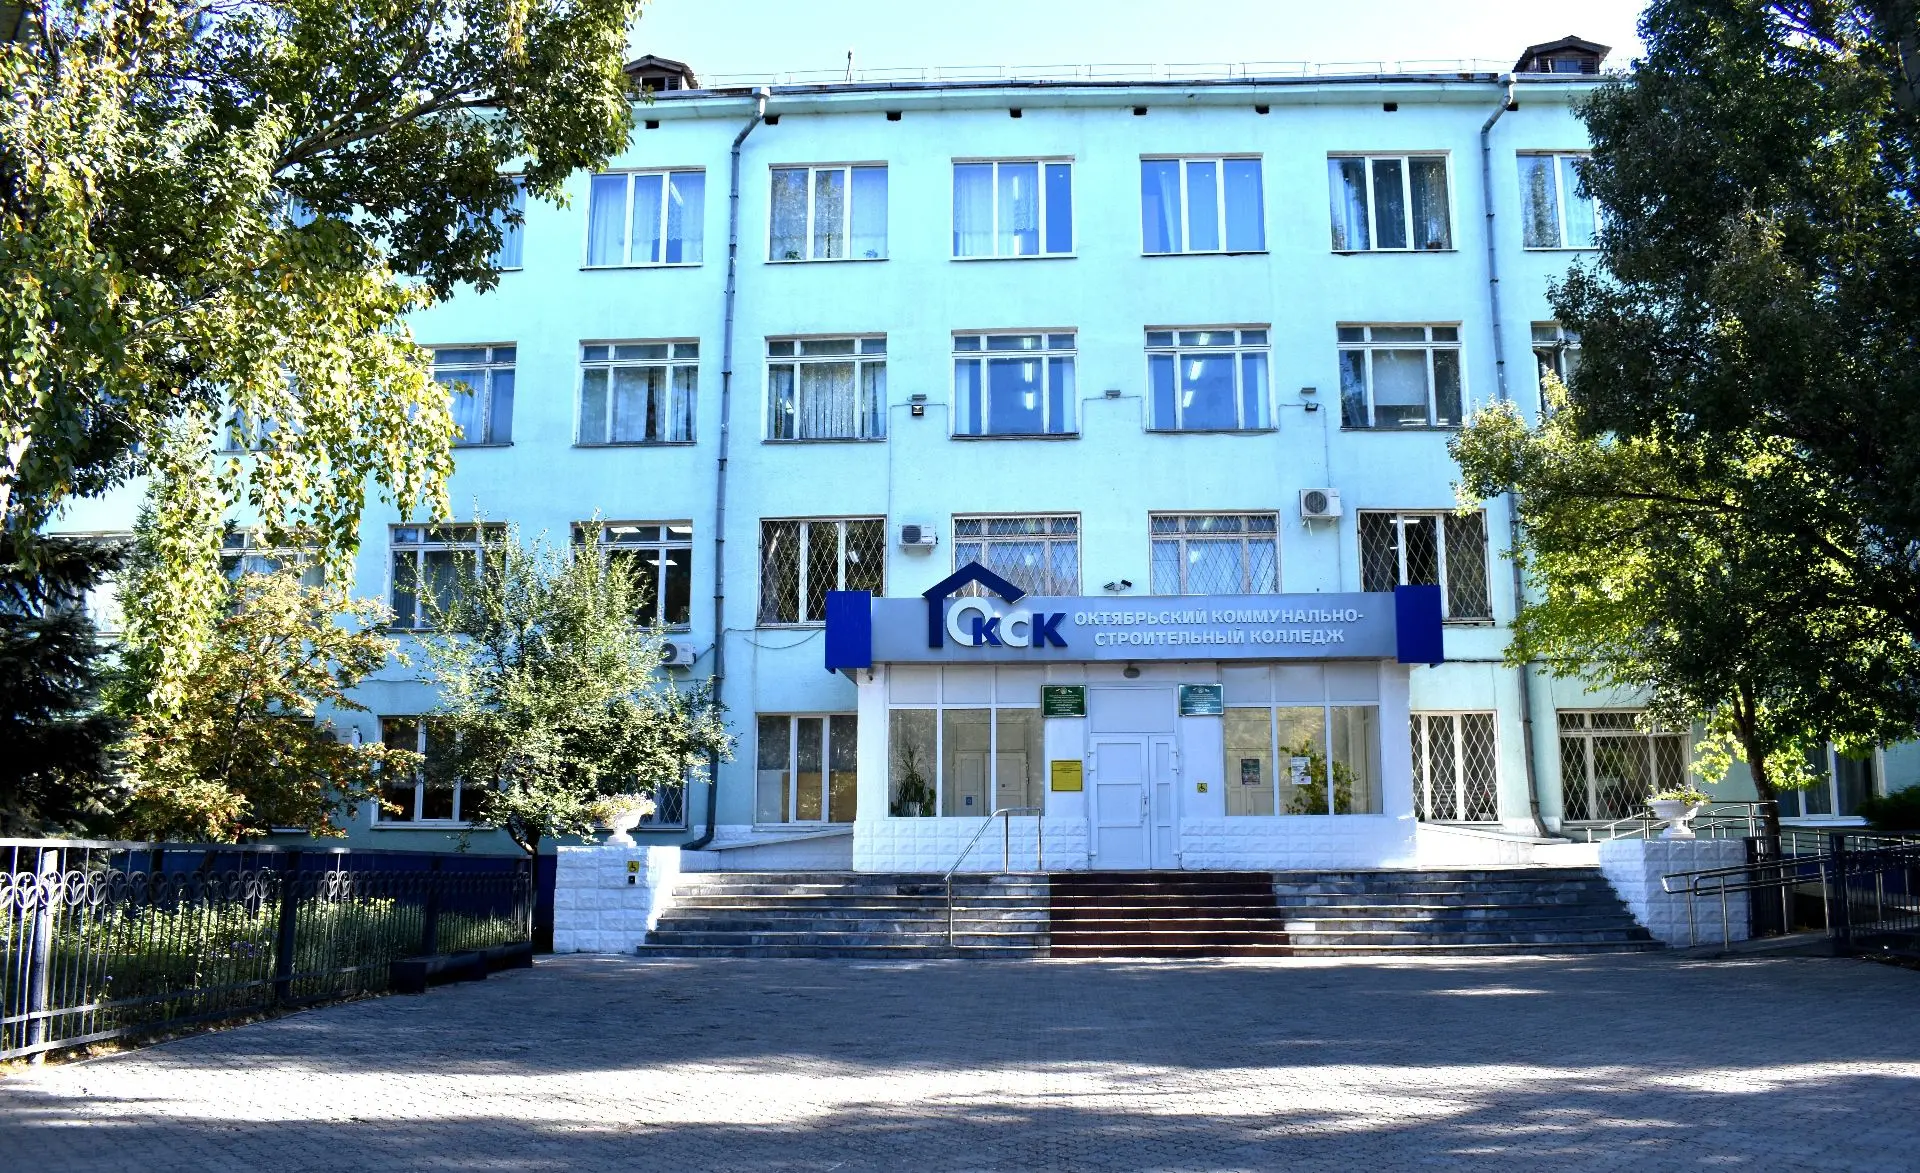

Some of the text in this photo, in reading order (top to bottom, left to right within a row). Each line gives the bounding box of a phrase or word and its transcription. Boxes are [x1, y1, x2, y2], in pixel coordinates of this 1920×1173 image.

[1074, 607, 1365, 625] ОКТЯБРЬСКИЙ КОММУНАЛЬНО-
[1094, 627, 1344, 646] СТРОИТЕЛЬНЫЙ КОЛЛЕДЖ
